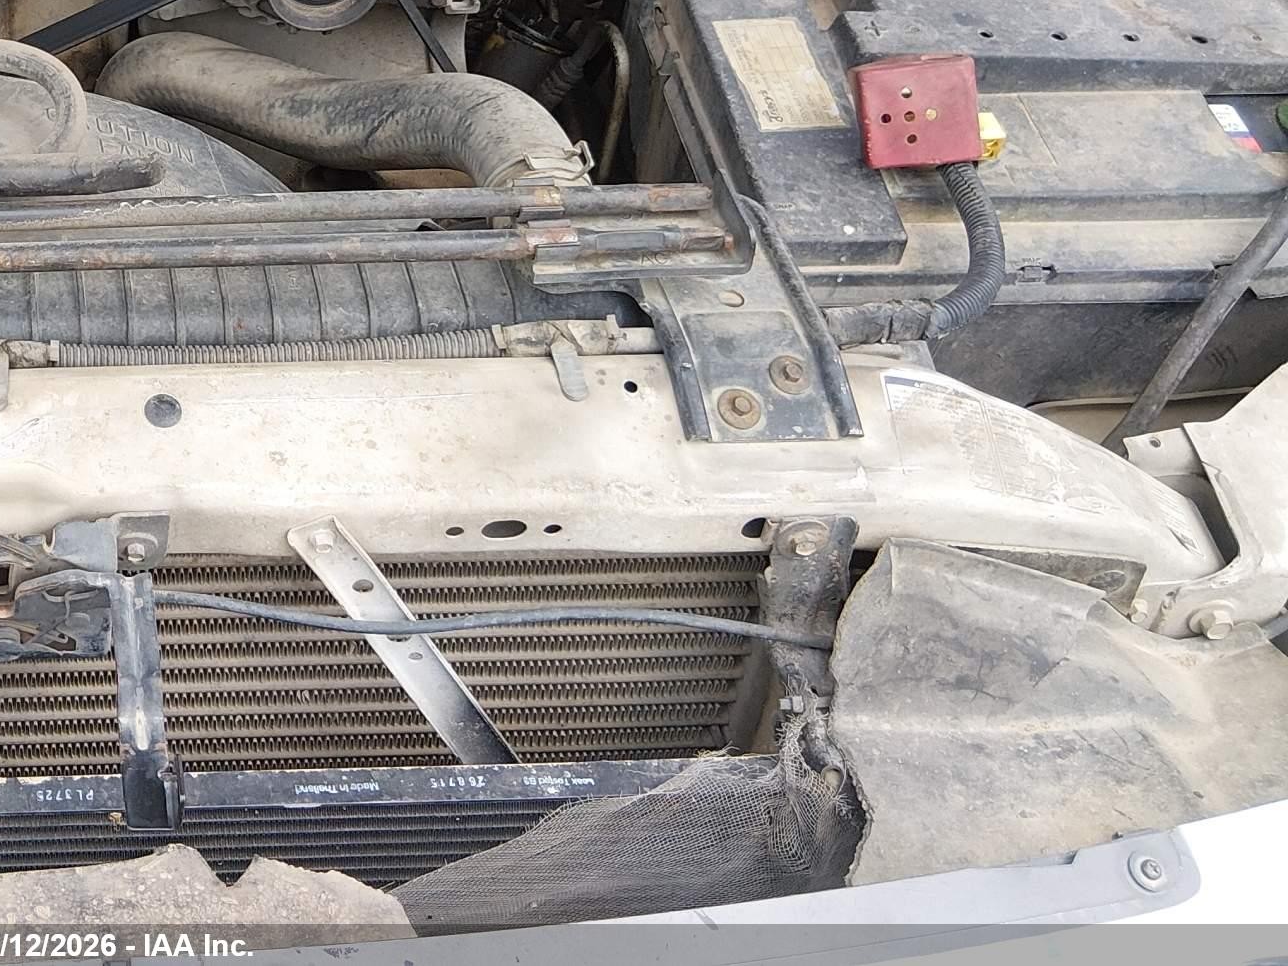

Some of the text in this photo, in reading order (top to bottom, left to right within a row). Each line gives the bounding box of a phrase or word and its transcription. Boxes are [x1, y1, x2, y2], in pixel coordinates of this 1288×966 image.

[45, 107, 196, 167] CUTION
[294, 784, 338, 795] Thailand
[350, 782, 380, 792] Made
